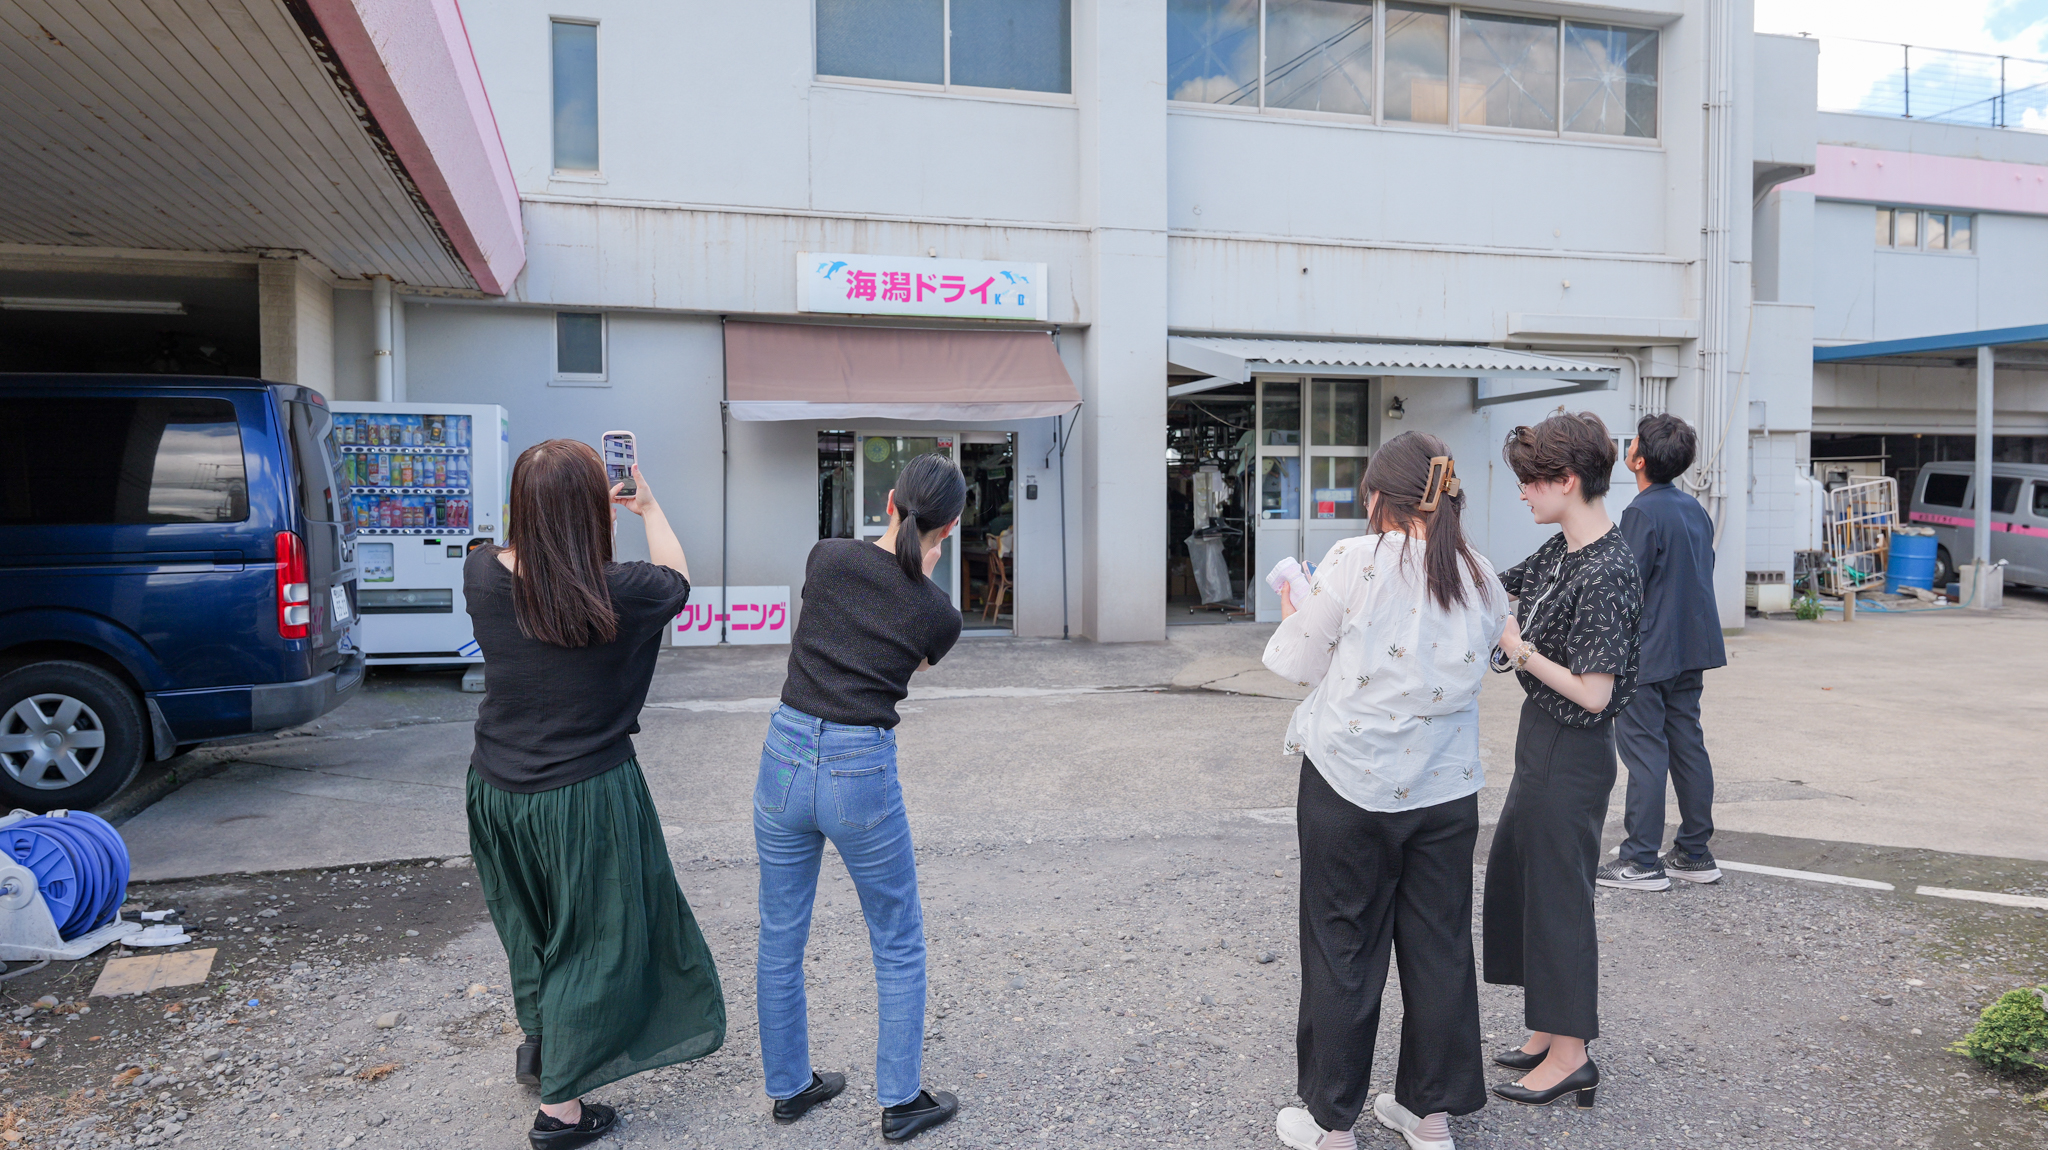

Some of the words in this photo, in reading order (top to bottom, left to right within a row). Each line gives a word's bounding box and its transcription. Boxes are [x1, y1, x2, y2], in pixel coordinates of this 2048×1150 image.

[846, 270, 996, 304] 海潟ドライ
[676, 602, 786, 632] クリーニング
